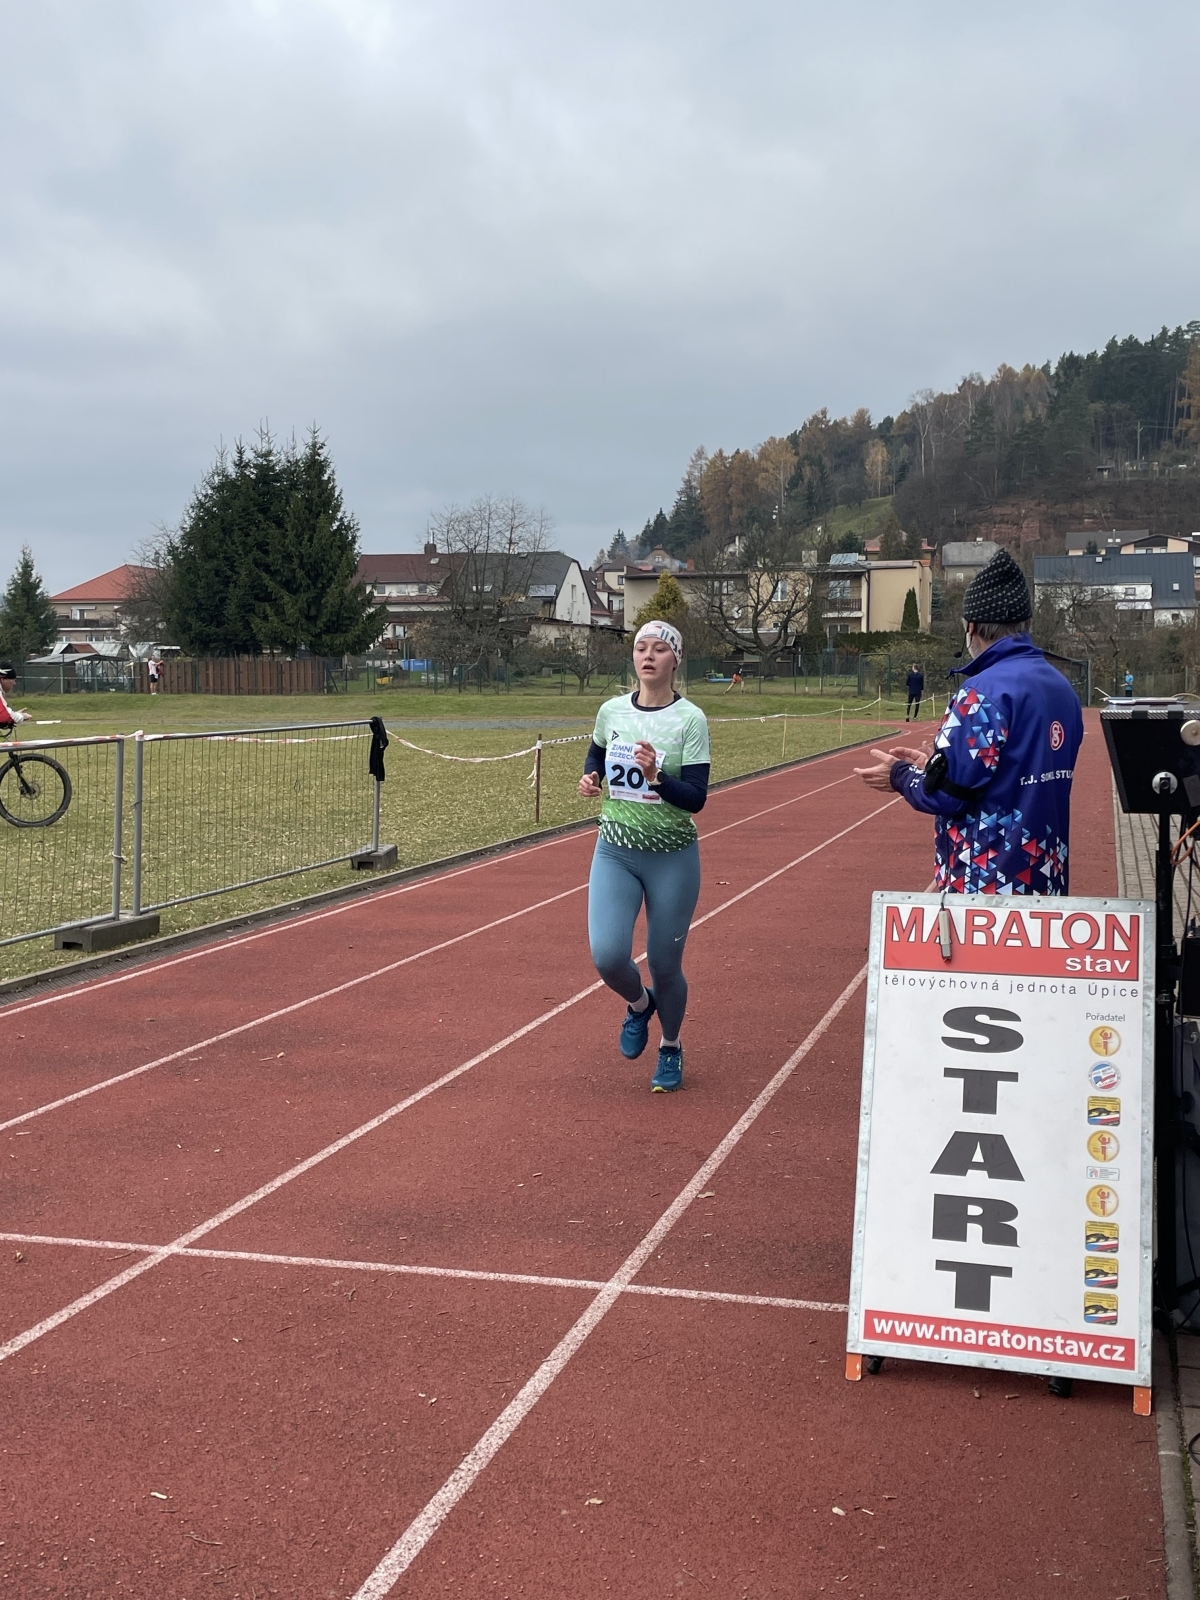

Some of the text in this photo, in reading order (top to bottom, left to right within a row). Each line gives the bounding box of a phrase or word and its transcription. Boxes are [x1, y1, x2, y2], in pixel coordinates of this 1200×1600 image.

[1020, 775, 1038, 786] T.J.
[885, 905, 1139, 951] MARATON
[1065, 954, 1131, 973] stav
[884, 974, 1139, 998] tělovýchovná jednota Úpice
[1085, 1012, 1126, 1022] Pořadatel
[872, 1316, 1126, 1362] www.maratonstav.cz
